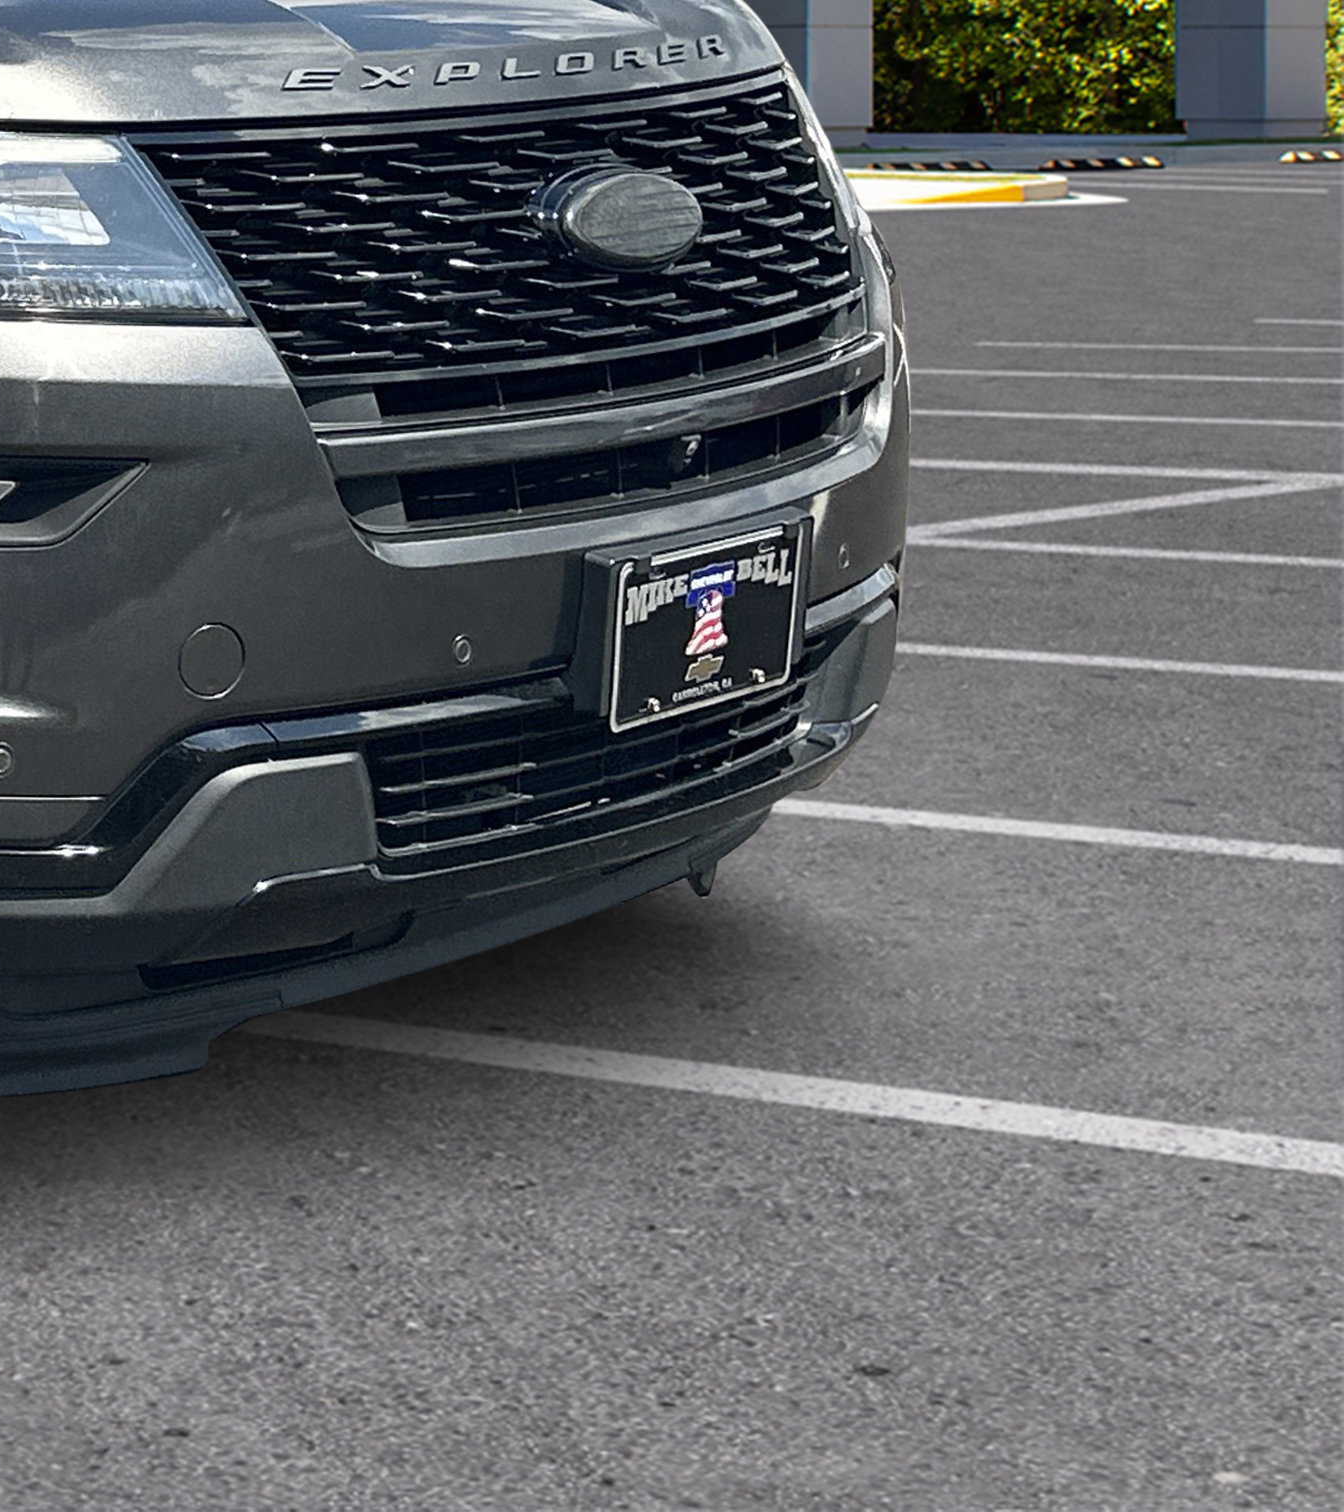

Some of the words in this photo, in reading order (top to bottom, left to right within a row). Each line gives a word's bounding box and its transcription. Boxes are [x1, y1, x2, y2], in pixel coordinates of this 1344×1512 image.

[281, 34, 728, 92] EXPLORER
[625, 574, 689, 626] MIKE
[737, 549, 793, 587] BELL
